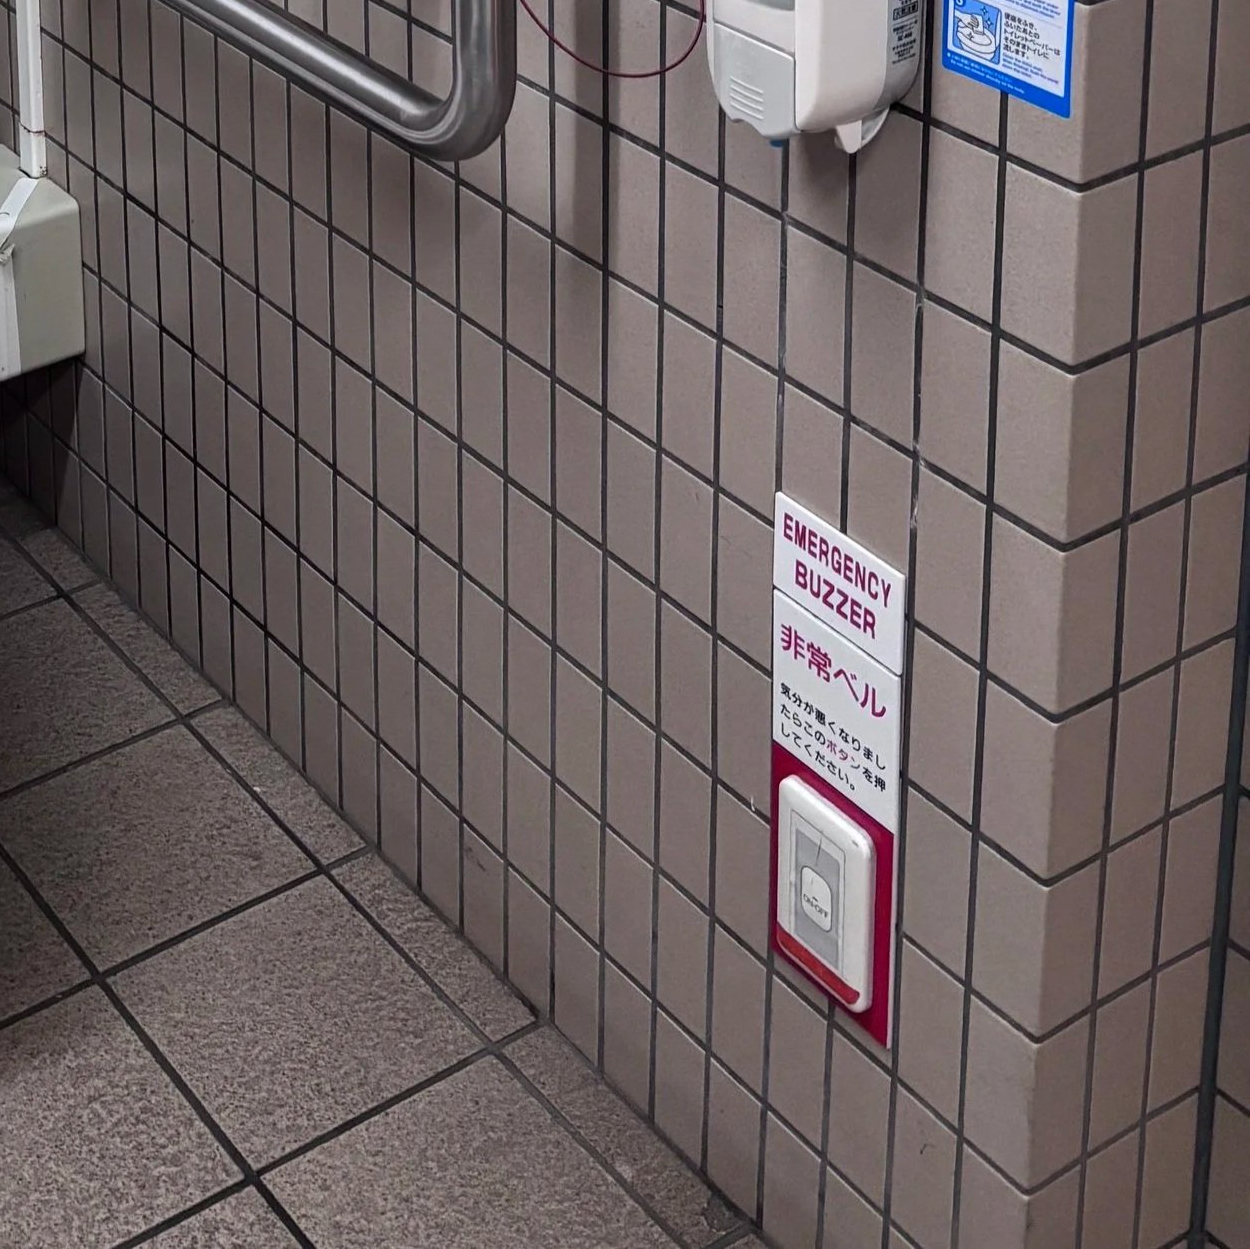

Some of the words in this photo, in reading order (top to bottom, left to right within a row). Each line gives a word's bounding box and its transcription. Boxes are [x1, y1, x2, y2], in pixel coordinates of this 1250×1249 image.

[1004, 28, 1060, 56] トイレットペーパーは
[784, 512, 891, 608] EMERGENCY
[795, 558, 876, 640] BUZZER
[780, 623, 886, 718] 非常ベル
[781, 682, 886, 770] 気分が悪くなりまし
[781, 722, 855, 791] してください。
